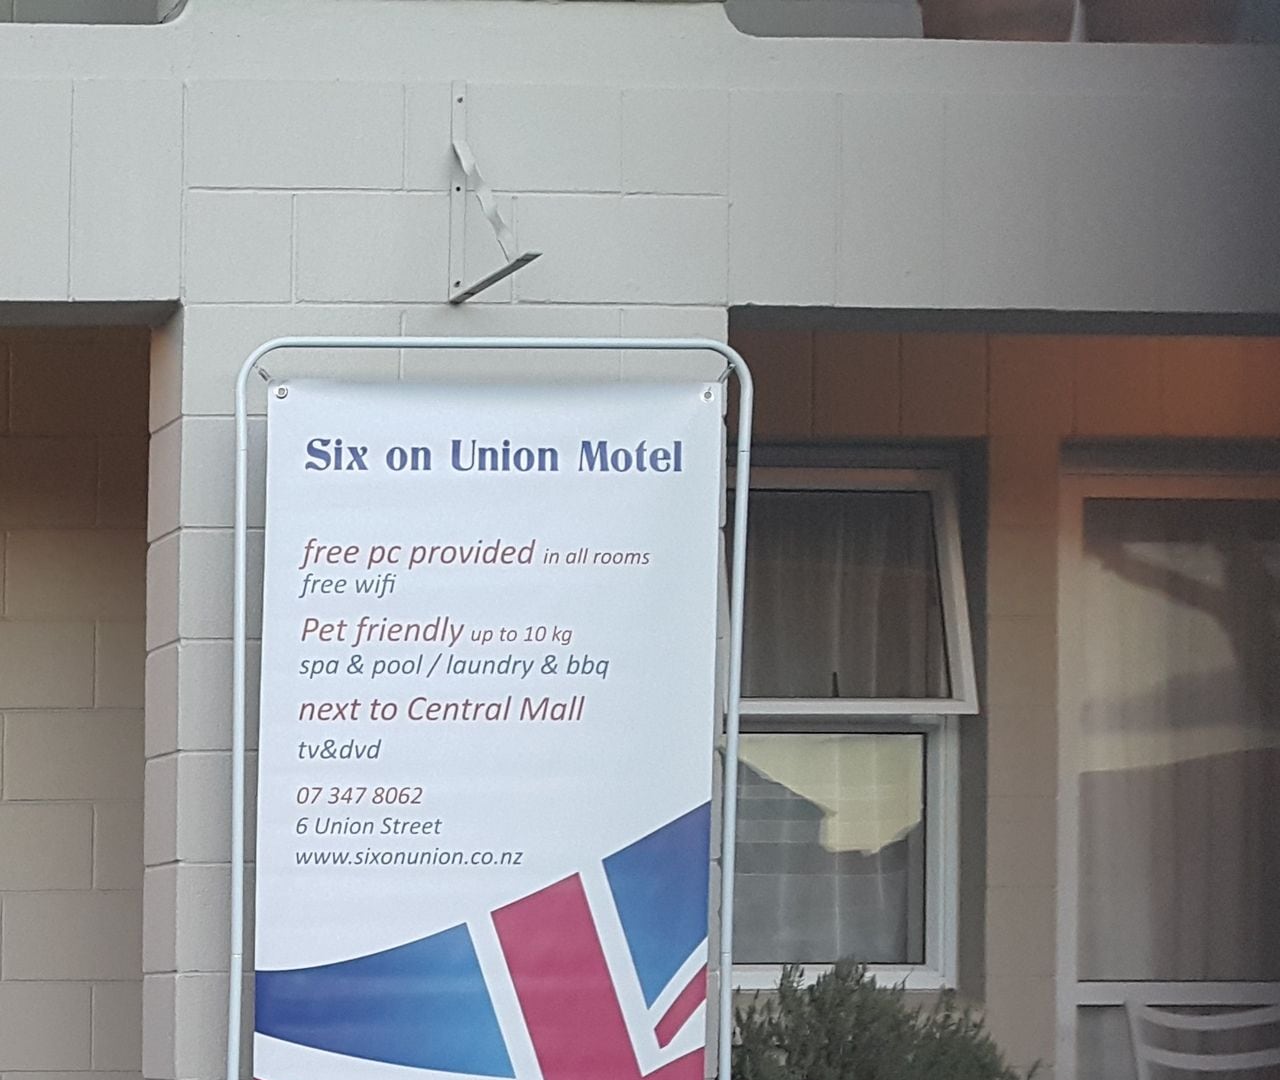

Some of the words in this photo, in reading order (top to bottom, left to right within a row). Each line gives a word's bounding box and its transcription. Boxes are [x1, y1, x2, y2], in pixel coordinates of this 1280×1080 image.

[305, 438, 368, 471] Six
[386, 447, 431, 471] on
[452, 439, 559, 472] Union
[578, 440, 682, 472] Motel
[299, 538, 359, 570] free
[367, 546, 402, 570] pc
[408, 539, 536, 570] provided
[543, 548, 559, 565] in
[566, 548, 588, 565] all
[593, 551, 651, 565] rooms
[299, 573, 347, 598] free
[355, 573, 397, 598] wifi
[301, 618, 348, 641] Pet
[351, 616, 465, 648] friendly
[471, 630, 493, 645] up
[500, 627, 517, 642] to
[523, 626, 547, 642] 10
[552, 625, 572, 645] kg
[299, 659, 339, 679] spa
[347, 654, 364, 675] &
[371, 654, 423, 679] pool
[446, 654, 534, 679] laundry
[541, 655, 558, 675] &
[566, 654, 609, 679] bbq
[299, 699, 361, 722] next
[370, 699, 397, 722] to
[408, 695, 512, 722] Central
[520, 696, 585, 722] Mall
[298, 739, 382, 760] tv&dvd
[297, 787, 323, 804] 07
[328, 787, 367, 804] 347
[372, 787, 423, 804] 8062
[296, 817, 310, 835] 6
[315, 817, 374, 835] Union
[380, 817, 443, 835] Street
[296, 848, 525, 866] www.sixonunion.co.nz
